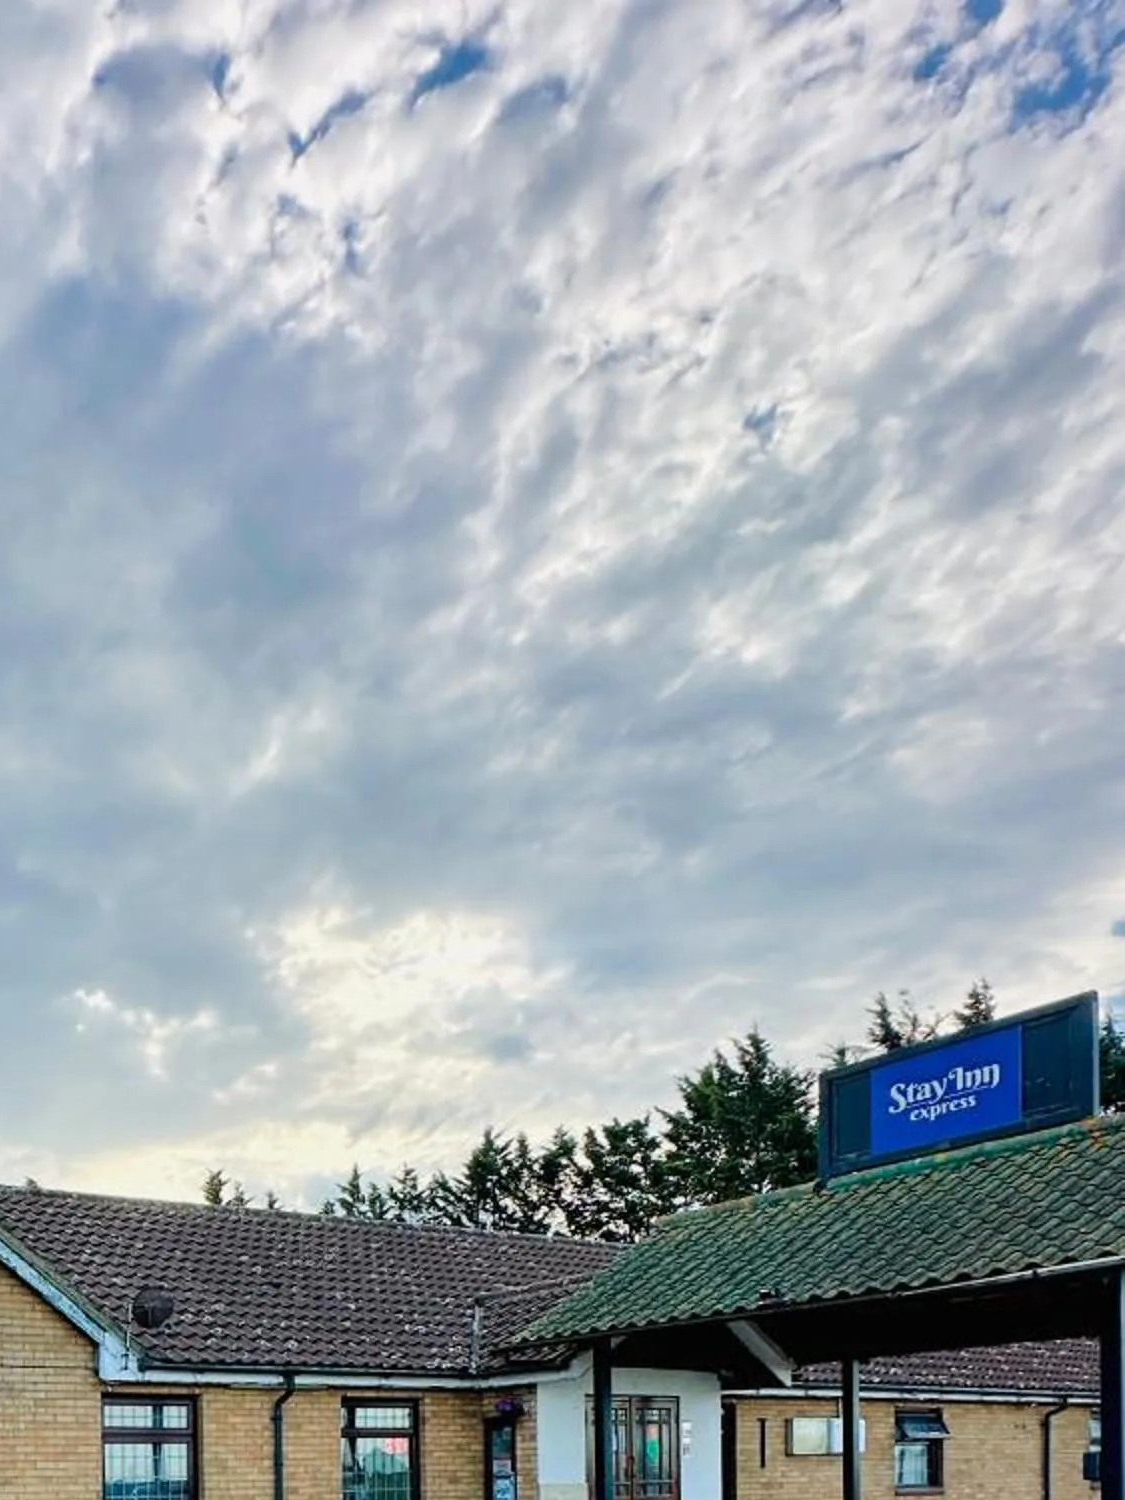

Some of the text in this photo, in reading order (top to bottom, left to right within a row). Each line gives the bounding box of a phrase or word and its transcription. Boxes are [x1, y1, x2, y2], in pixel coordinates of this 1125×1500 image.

[889, 1063, 1000, 1113] Stay Inn
[910, 1095, 977, 1121] express
